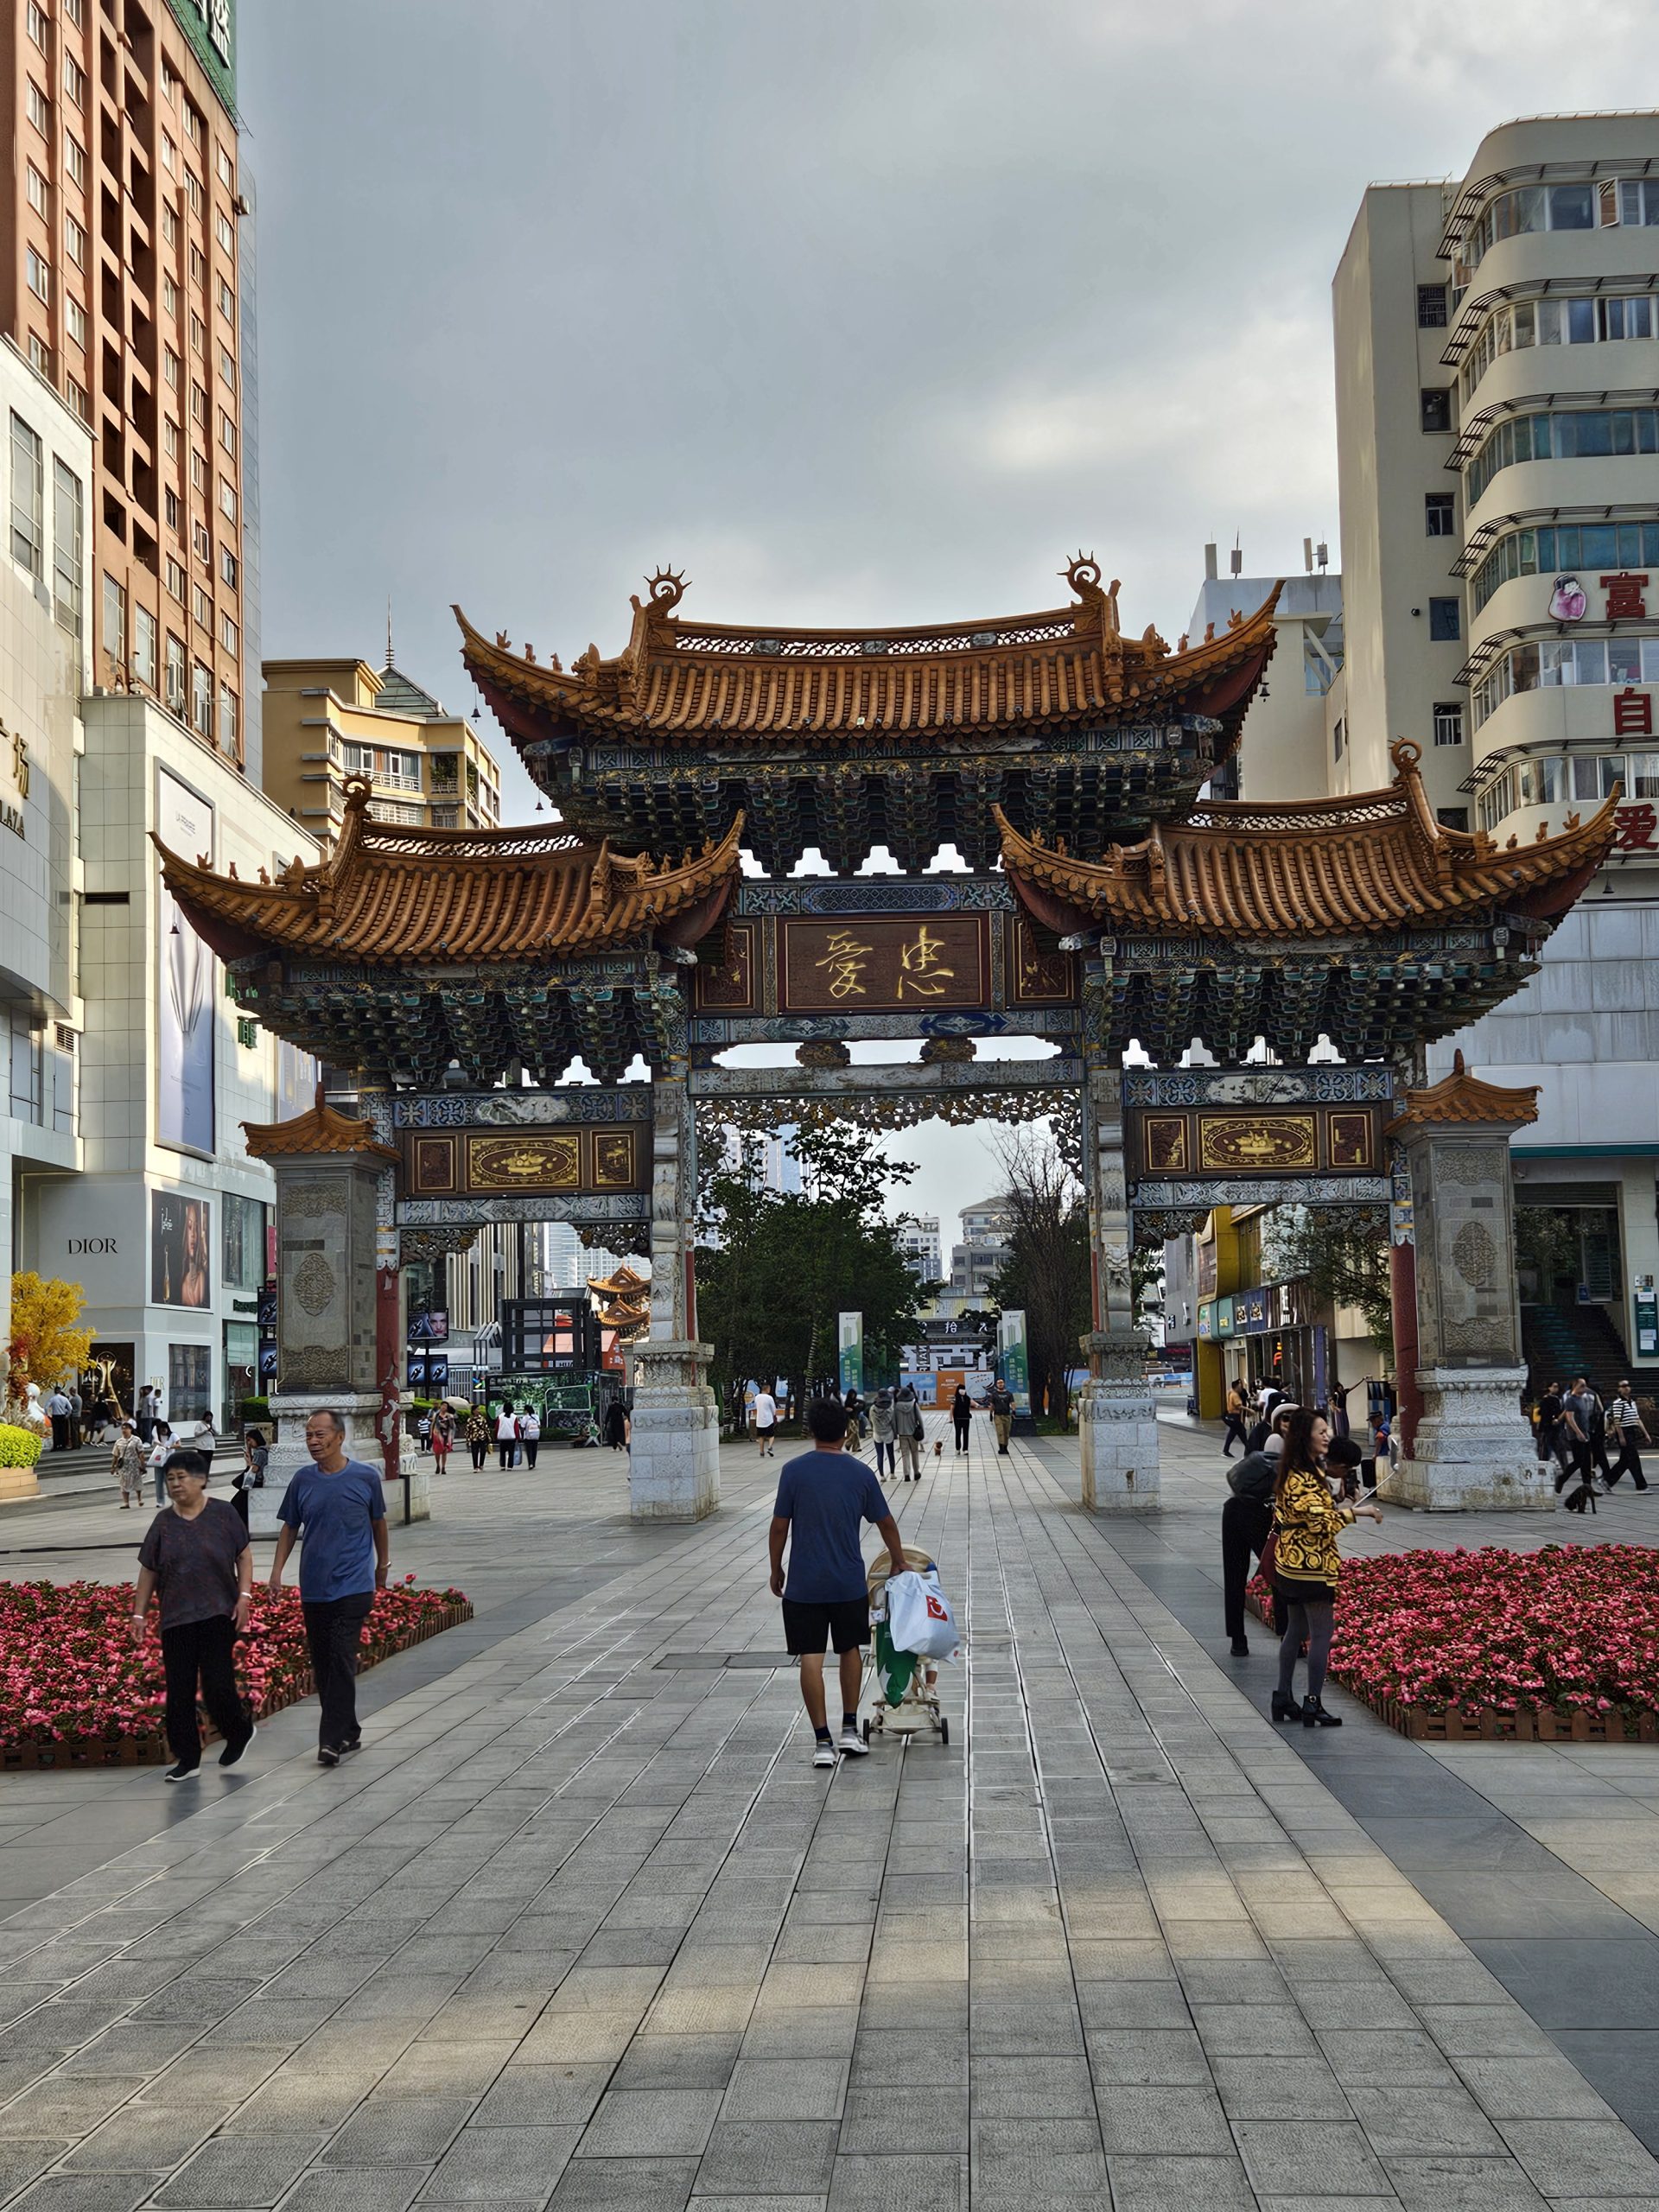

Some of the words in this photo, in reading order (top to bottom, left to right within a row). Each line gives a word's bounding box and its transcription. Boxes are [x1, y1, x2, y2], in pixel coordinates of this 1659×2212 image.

[1599, 571, 1649, 620] 富
[1613, 687, 1651, 734] 自
[0, 717, 29, 799] 场
[1614, 803, 1658, 851] 爱
[68, 1237, 118, 1254] DIOR
